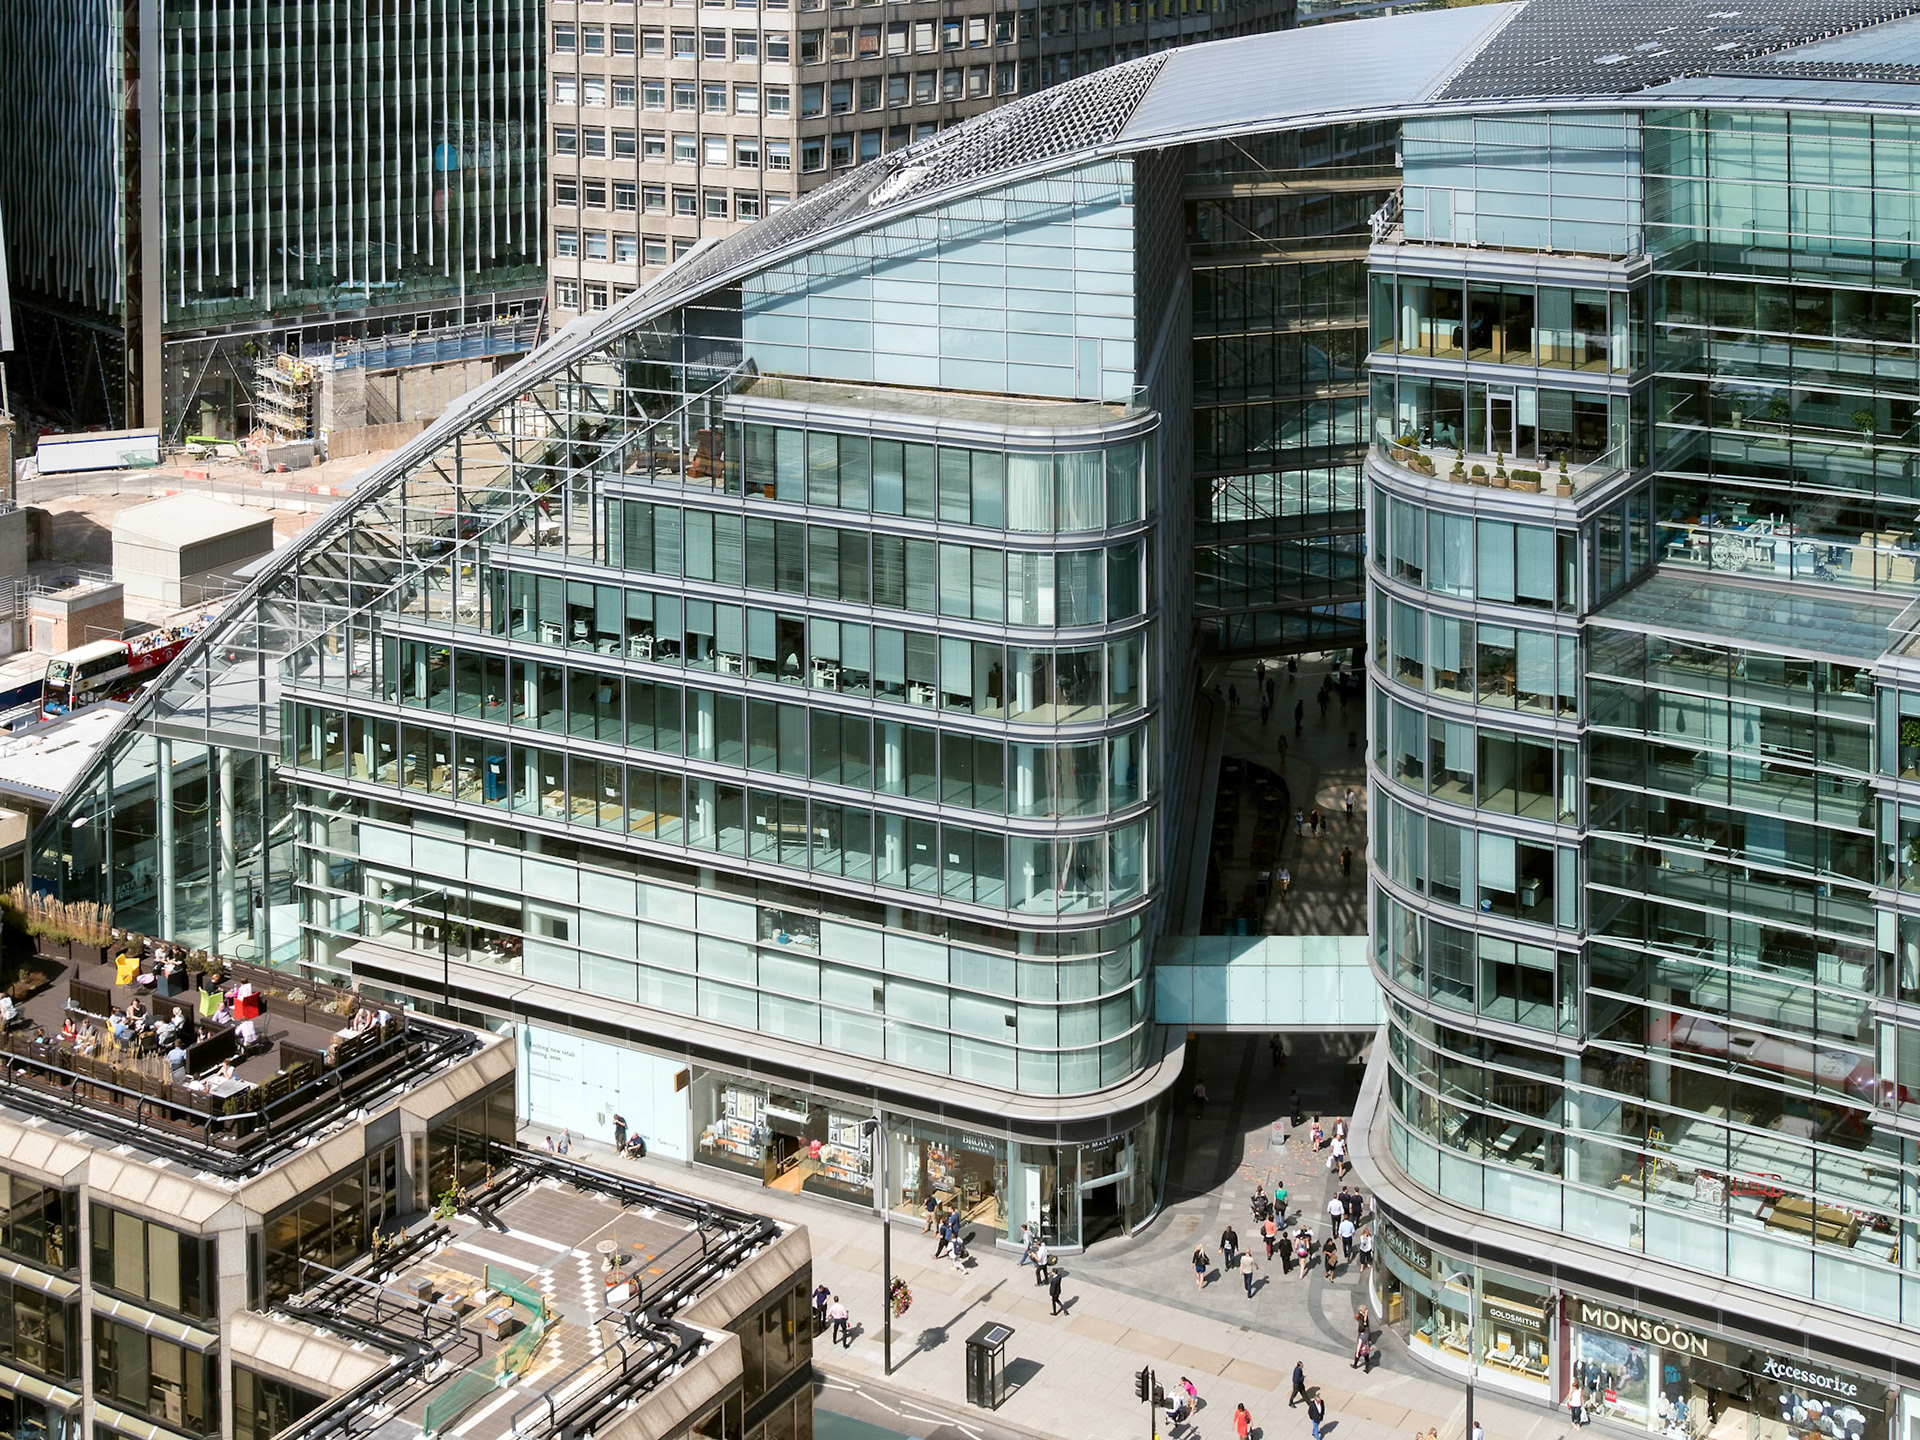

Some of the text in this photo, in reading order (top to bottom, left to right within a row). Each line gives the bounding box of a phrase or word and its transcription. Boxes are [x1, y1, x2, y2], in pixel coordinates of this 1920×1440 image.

[962, 1134, 995, 1150] BROWN
[1490, 1308, 1541, 1328] GOLDSMITHS
[1582, 1303, 1708, 1357] MONSOON
[1762, 1356, 1858, 1396] Accessorize
